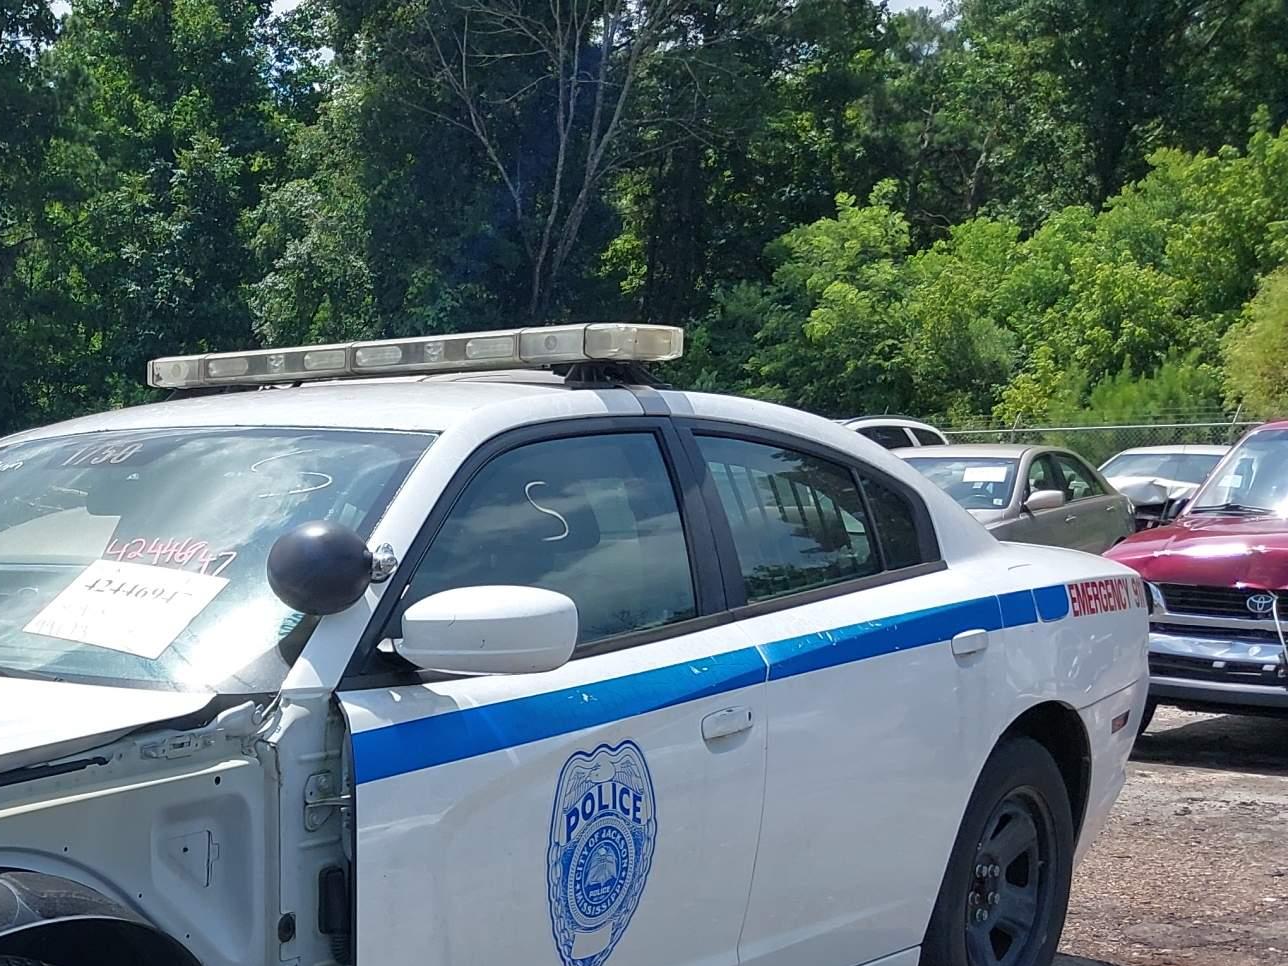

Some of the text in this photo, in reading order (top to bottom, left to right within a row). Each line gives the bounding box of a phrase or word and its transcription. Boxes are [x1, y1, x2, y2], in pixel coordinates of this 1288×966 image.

[524, 481, 570, 542] S
[106, 537, 237, 577] 42446947
[1068, 578, 1132, 617] EMERGENCY
[566, 782, 643, 842] POLICE
[576, 829, 628, 880] CITY OF JACKSON
[575, 880, 624, 915] MISSISSIPPI
